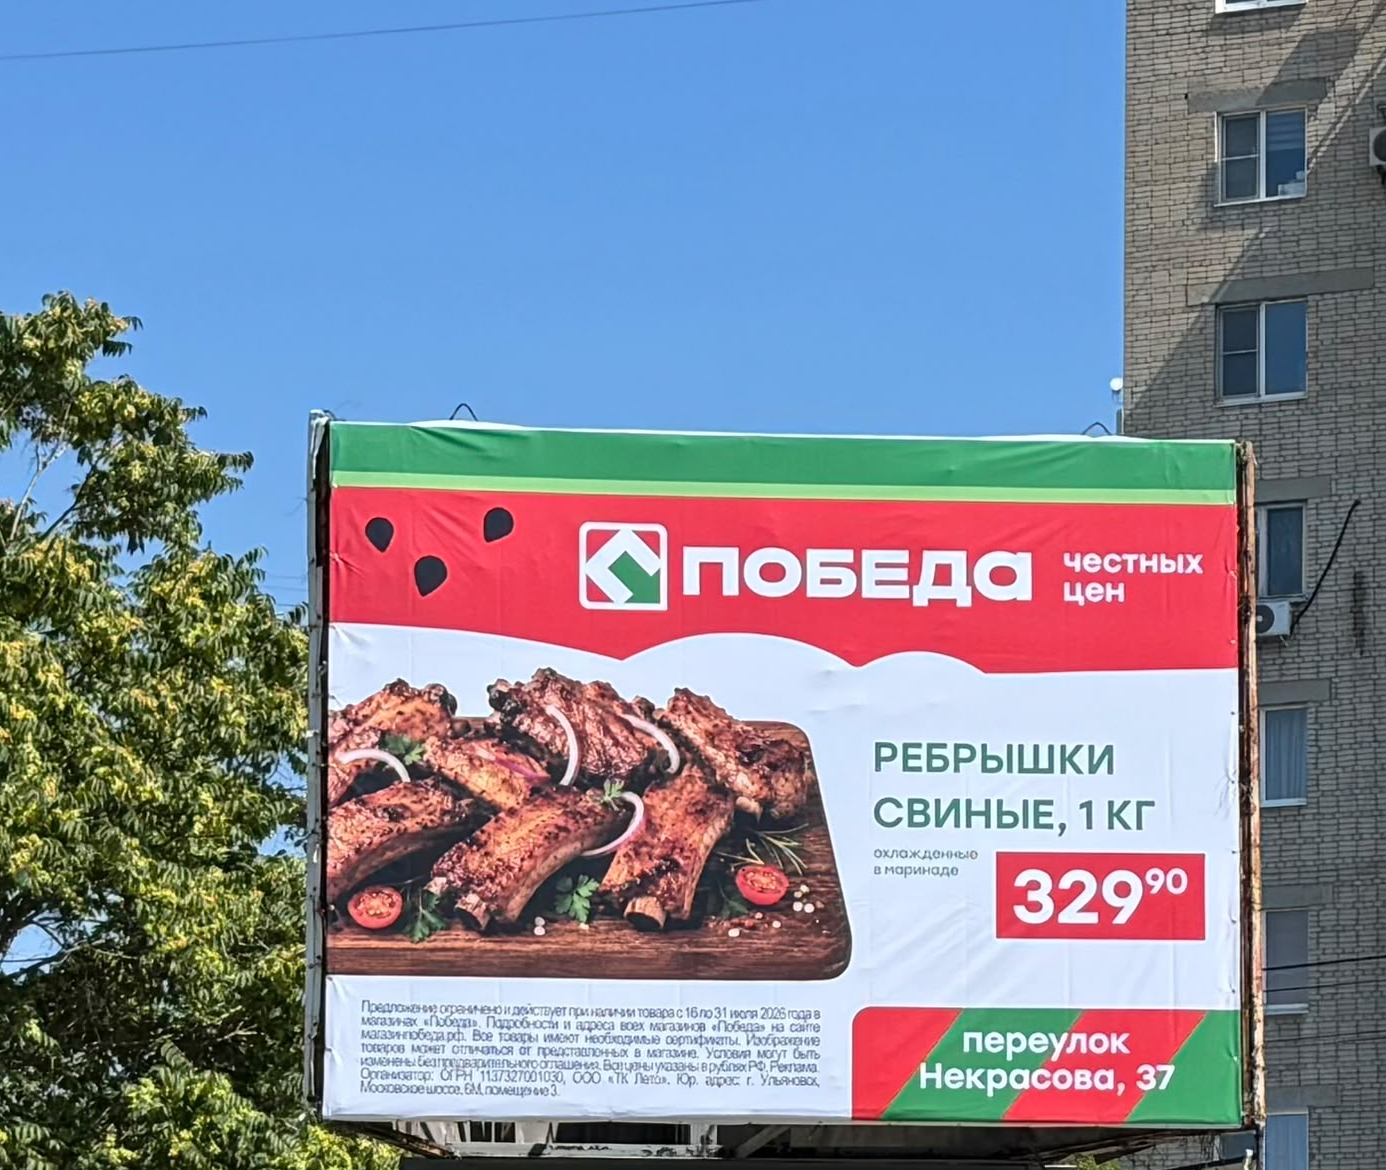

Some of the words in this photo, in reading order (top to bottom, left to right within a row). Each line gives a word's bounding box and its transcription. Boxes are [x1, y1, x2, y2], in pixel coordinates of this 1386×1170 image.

[1063, 553, 1203, 575] честных
[1063, 582, 1125, 606] цен
[873, 741, 1115, 776] РЕБРЫШКИ
[873, 796, 1068, 837] СВИНЫЕ,
[1078, 799, 1095, 831] 1
[1107, 799, 1157, 831] КГ
[872, 848, 979, 861] охлажденные
[873, 865, 882, 875] в
[884, 865, 960, 879] маринаде
[1012, 868, 1144, 925] 329
[1145, 868, 1189, 895] 90
[676, 1008, 683, 1018] с
[686, 1006, 698, 1018] 16
[714, 1006, 727, 1019] 31
[814, 1010, 821, 1020] в
[564, 1020, 570, 1030] и
[771, 1023, 785, 1033] на
[634, 1048, 641, 1058] в
[963, 1031, 1131, 1062] переулок
[919, 1061, 1126, 1096] Некрасова,
[1136, 1064, 1177, 1092] 37
